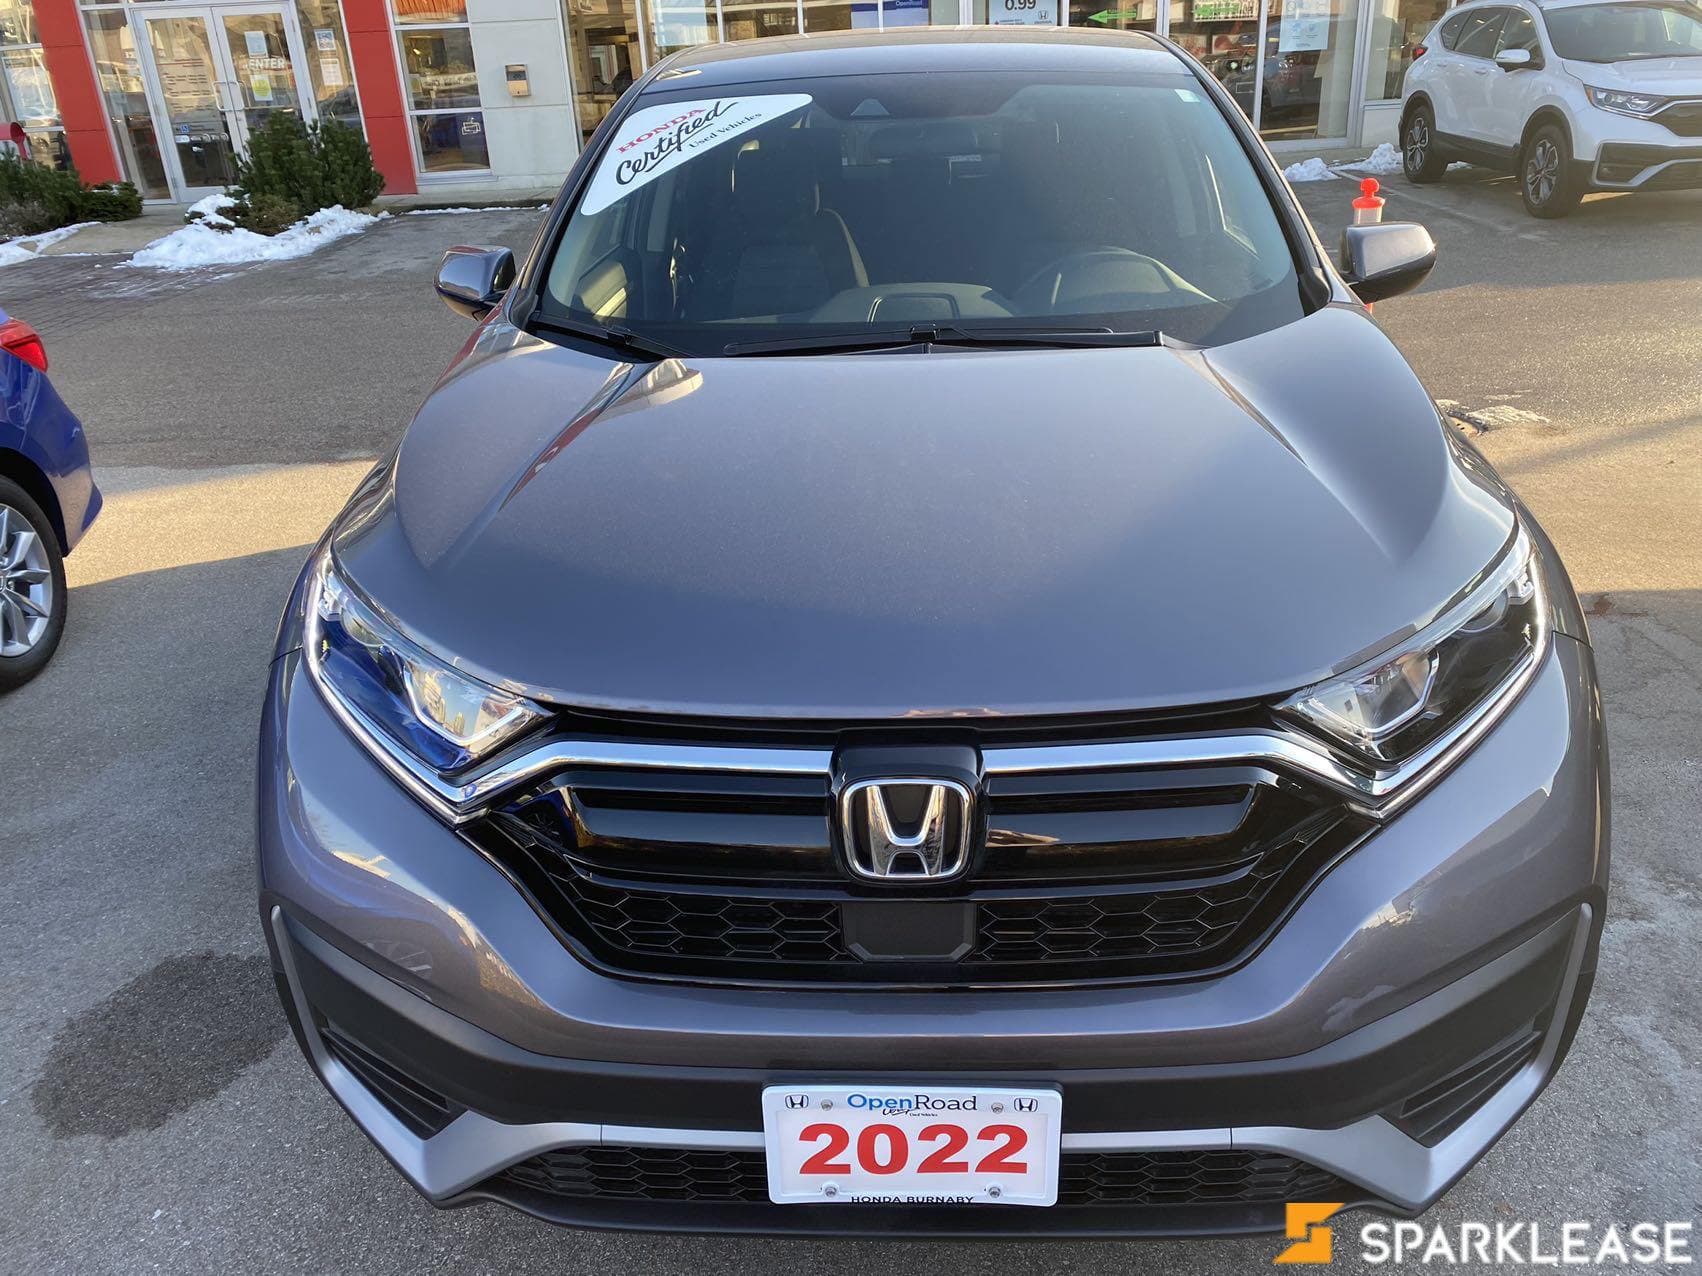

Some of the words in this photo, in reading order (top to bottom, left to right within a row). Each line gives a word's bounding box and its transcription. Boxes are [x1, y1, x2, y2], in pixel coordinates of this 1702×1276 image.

[249, 58, 285, 70] ENTER
[616, 101, 738, 185] Certified
[617, 109, 706, 154] HONDA
[689, 132, 717, 148] Used
[718, 113, 762, 133] Vehicles
[847, 1093, 977, 1111] OpenRoad
[799, 1123, 1029, 1175] 2022
[851, 1196, 902, 1204] HONDA
[906, 1196, 974, 1204] BURNABY
